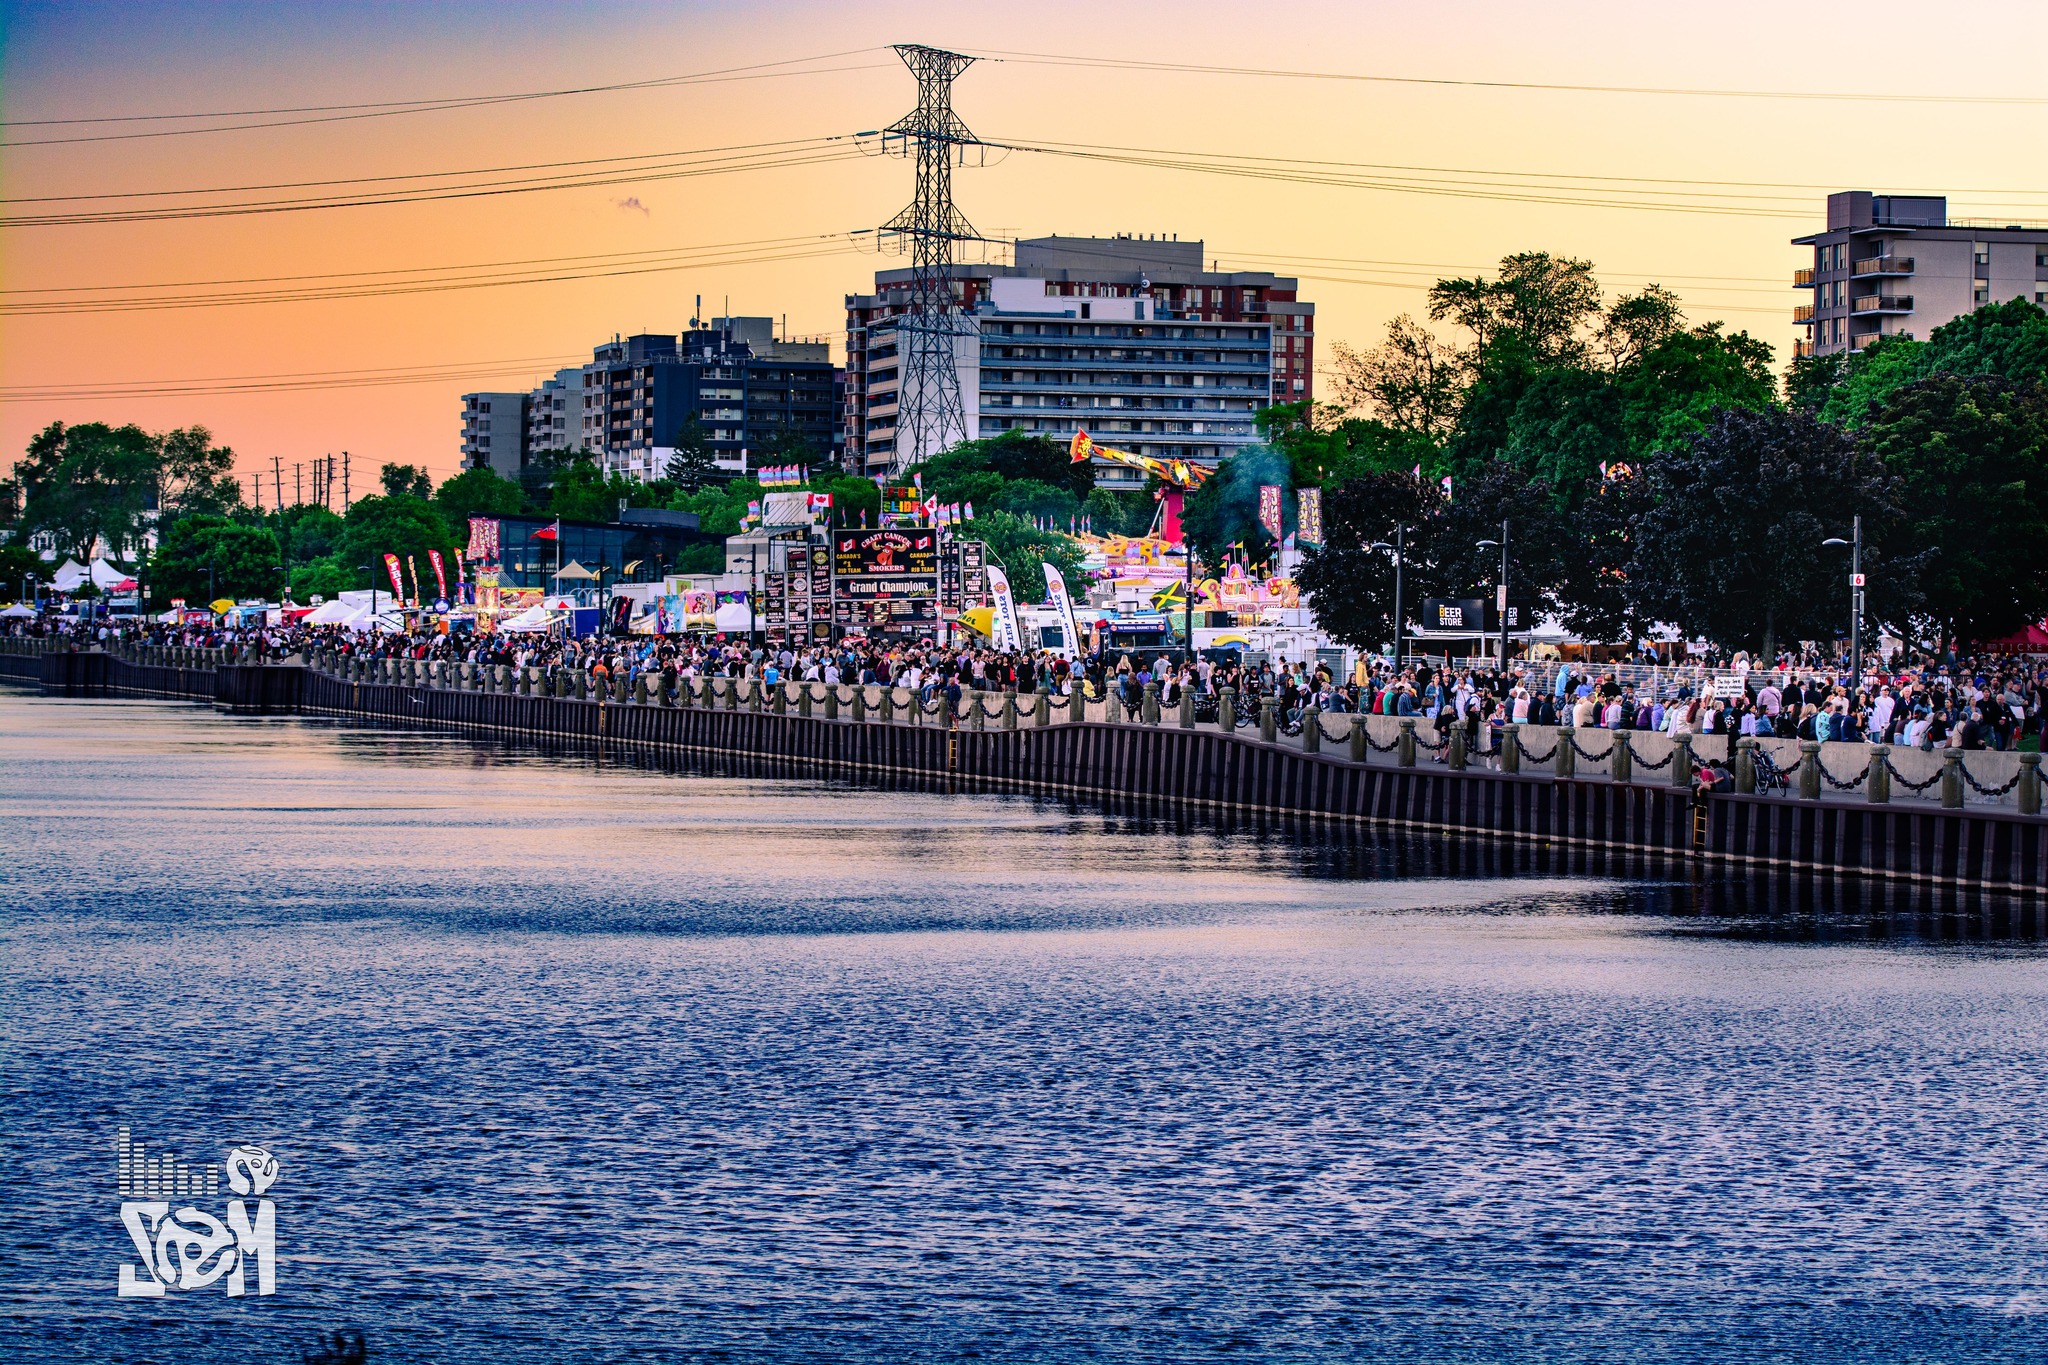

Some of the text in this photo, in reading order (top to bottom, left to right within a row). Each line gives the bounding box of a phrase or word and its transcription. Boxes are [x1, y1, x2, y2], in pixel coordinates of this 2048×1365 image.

[887, 487, 916, 498] FUN
[883, 501, 920, 512] SLIDE
[861, 532, 912, 549] CRAZY CANUCK
[869, 564, 905, 572] SMOKERS
[1856, 575, 1861, 584] 6
[850, 582, 877, 592] Grand
[880, 581, 928, 593] Champions
[1187, 583, 1192, 591] 7
[1439, 605, 1462, 617] BEER
[1439, 618, 1463, 626] STORE
[1499, 618, 1518, 626] SRE
[1999, 643, 2048, 652] TICKE
